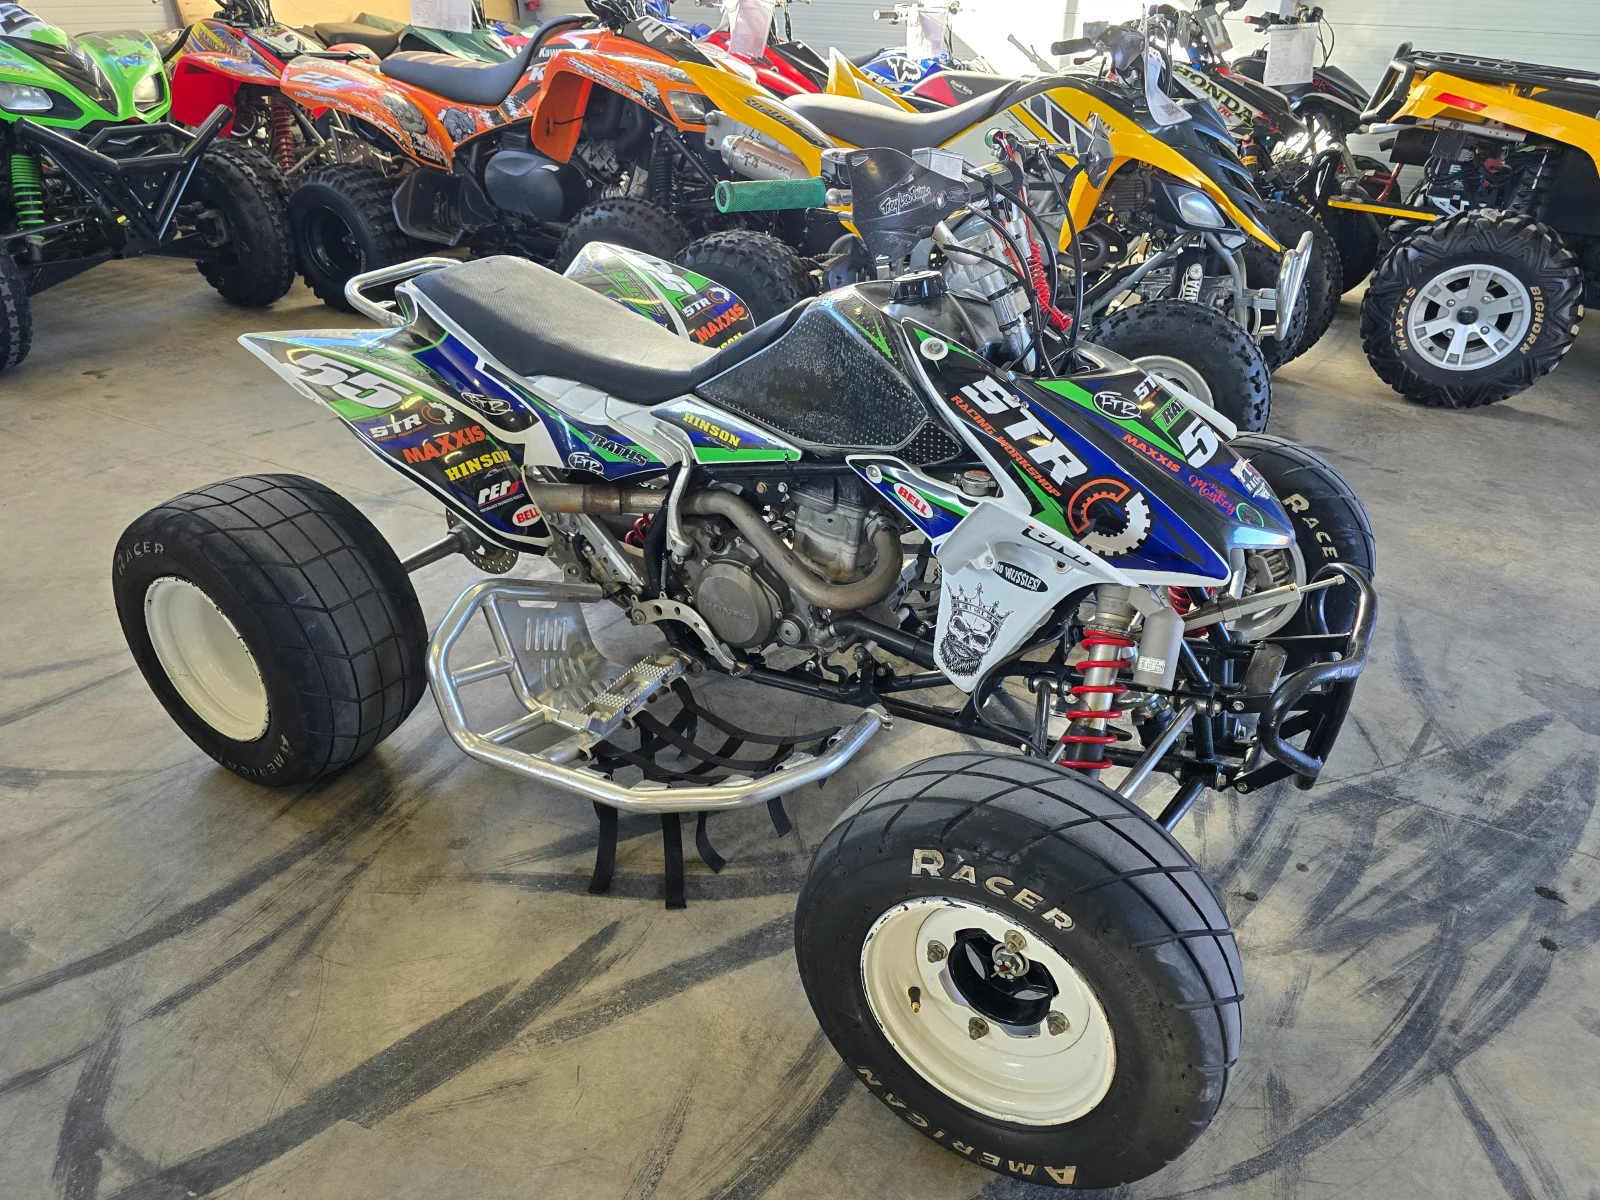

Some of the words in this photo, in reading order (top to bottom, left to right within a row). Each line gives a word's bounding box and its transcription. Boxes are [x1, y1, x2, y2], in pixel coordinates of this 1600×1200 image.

[1173, 64, 1255, 127] HONDA
[682, 297, 711, 318] STR
[696, 303, 745, 344] MAXXIS
[1395, 286, 1417, 351] MAXXIS
[1519, 286, 1545, 355] BIGHORN
[282, 353, 414, 409] 55
[1133, 375, 1158, 401] ST
[369, 413, 423, 438] STR
[402, 425, 486, 464] MAXXIS
[683, 412, 740, 447] HINSON
[950, 394, 997, 435] RACING
[996, 436, 1062, 497] WORKSHOP
[959, 375, 1088, 486] STR
[444, 450, 512, 481] HINSON
[588, 433, 650, 467] RATHS
[1122, 433, 1181, 473] MAXXIS
[516, 507, 540, 524] BELL
[897, 485, 928, 517] BELL
[1281, 493, 1339, 558] RACE
[115, 541, 165, 576] RACER
[911, 848, 1075, 931] RACER
[857, 1067, 1078, 1186] AMERICAN
